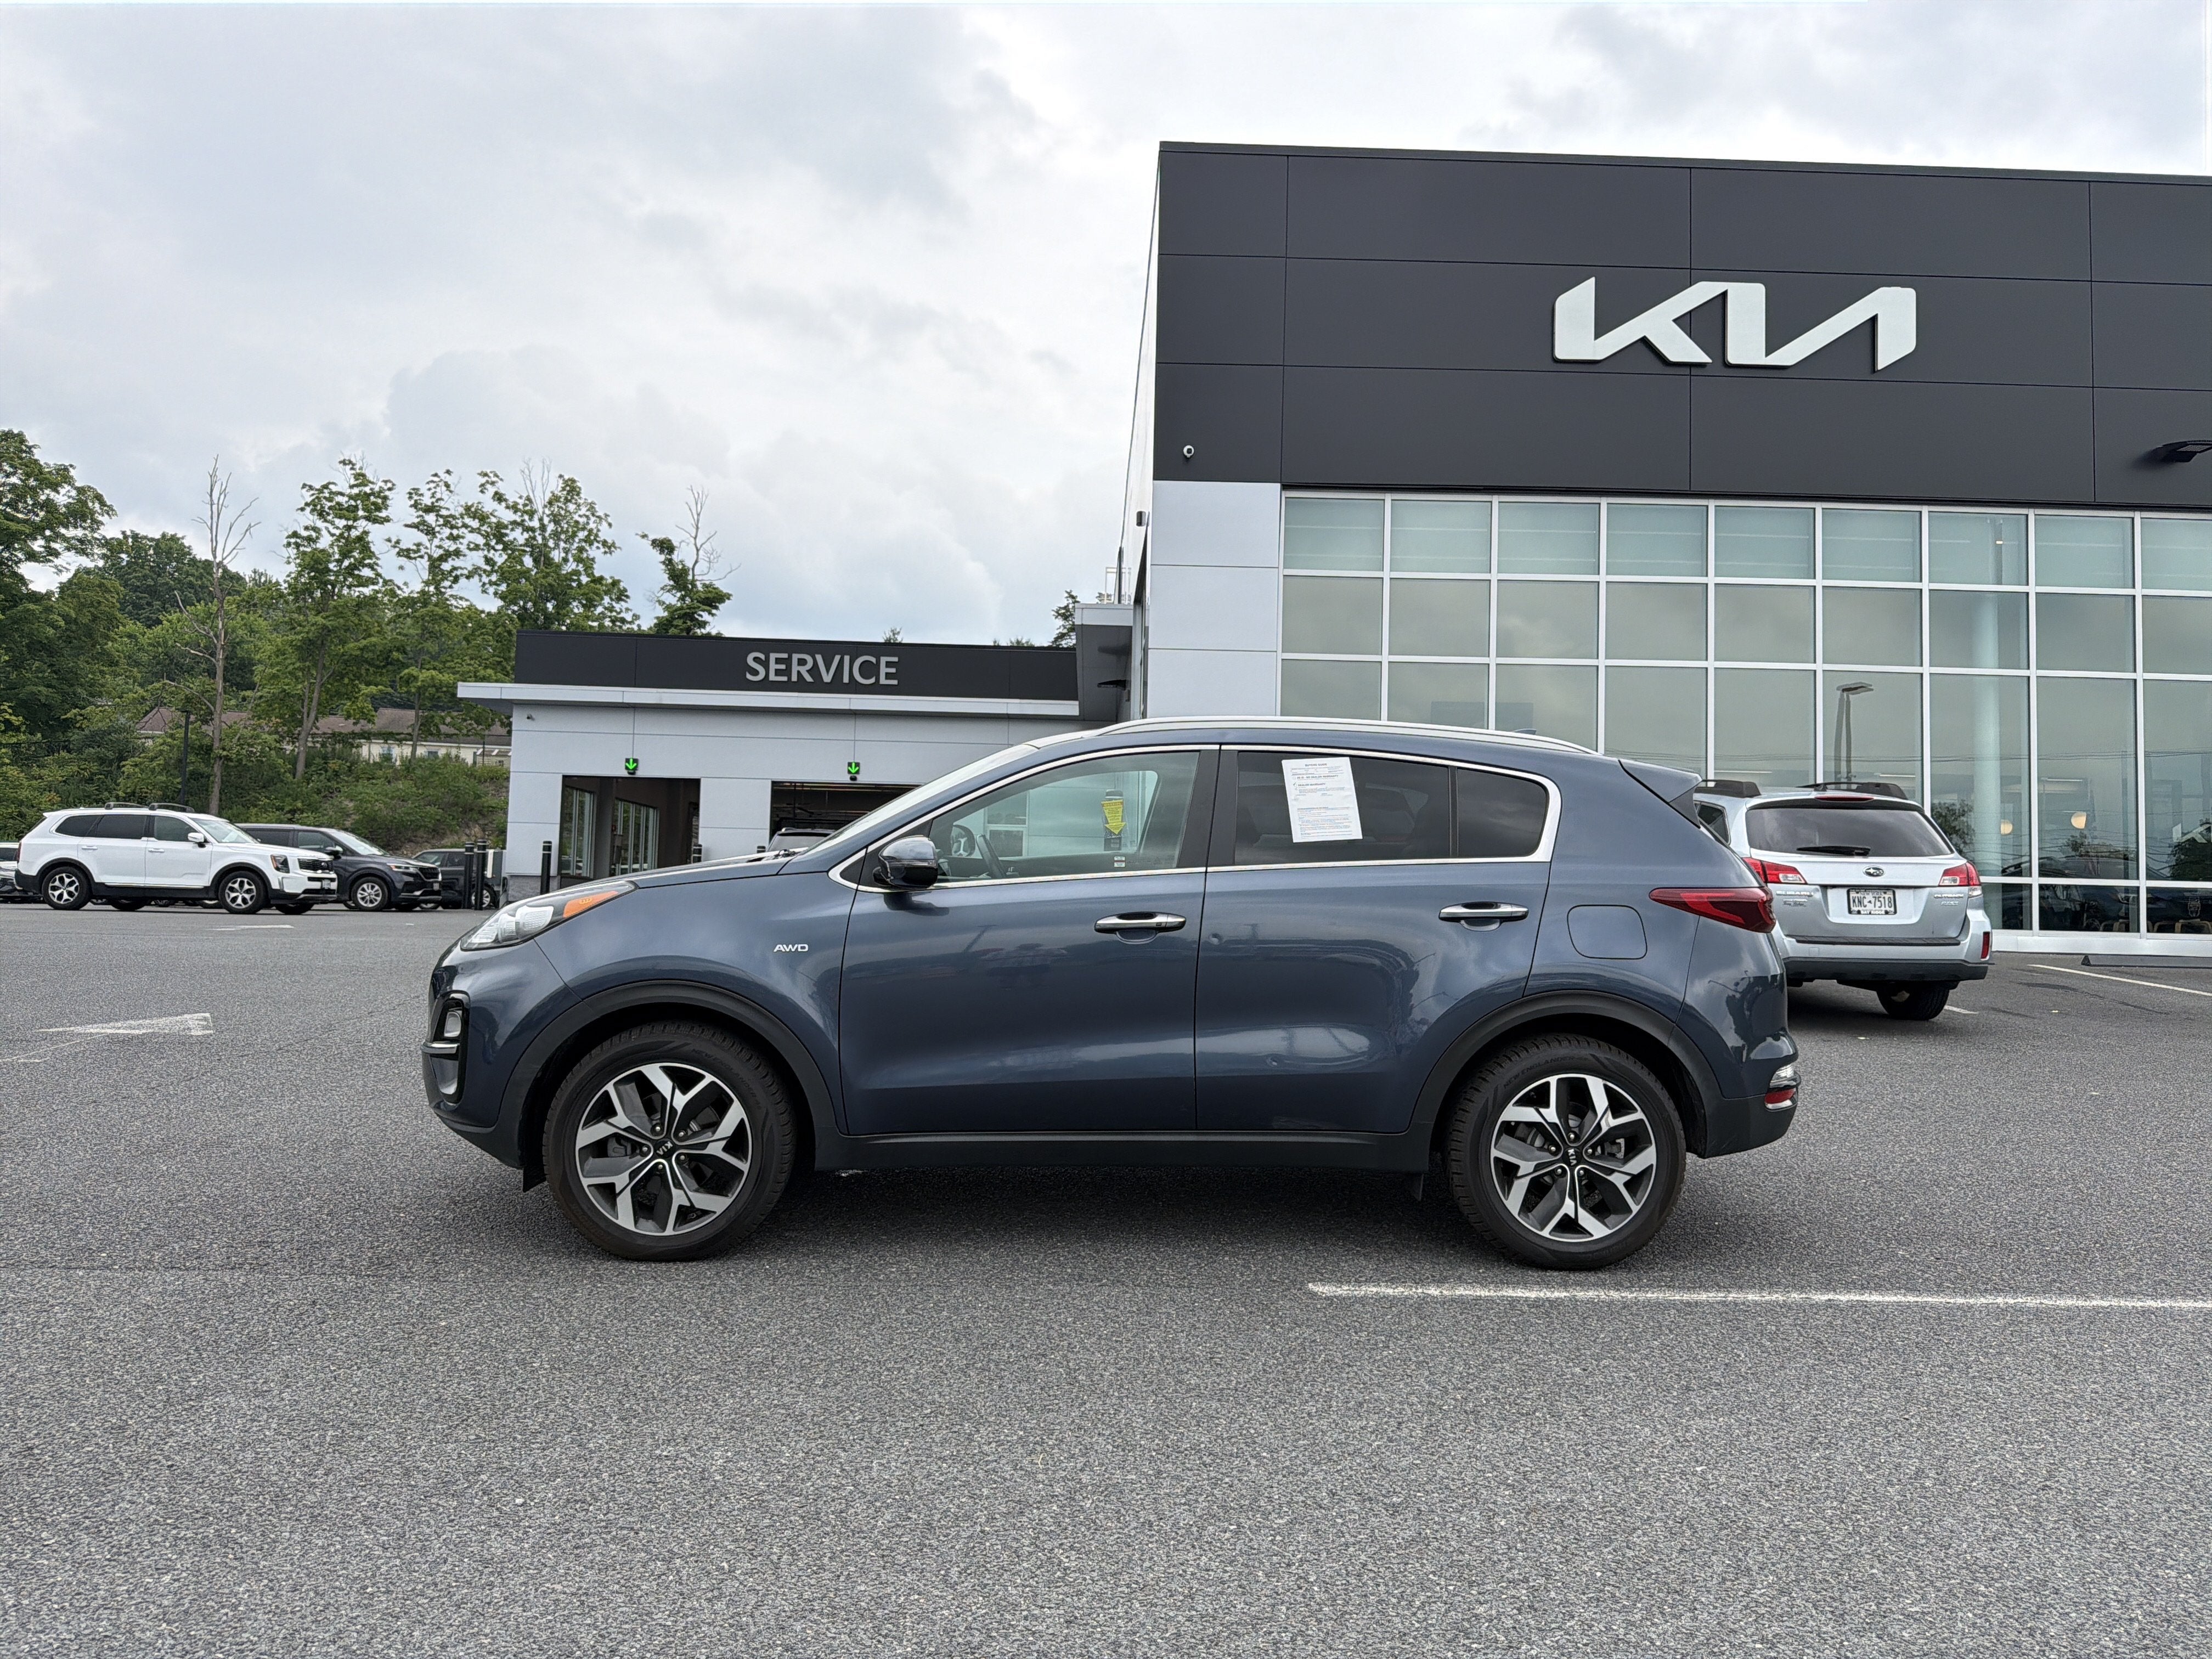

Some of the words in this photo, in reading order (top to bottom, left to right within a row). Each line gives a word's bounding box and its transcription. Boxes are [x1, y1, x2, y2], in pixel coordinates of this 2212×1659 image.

[1554, 276, 1916, 371] KIA
[746, 652, 899, 685] SERVICE
[1852, 896, 1867, 908] KNC
[1872, 896, 1893, 909] 7518
[773, 944, 809, 952] AWD
